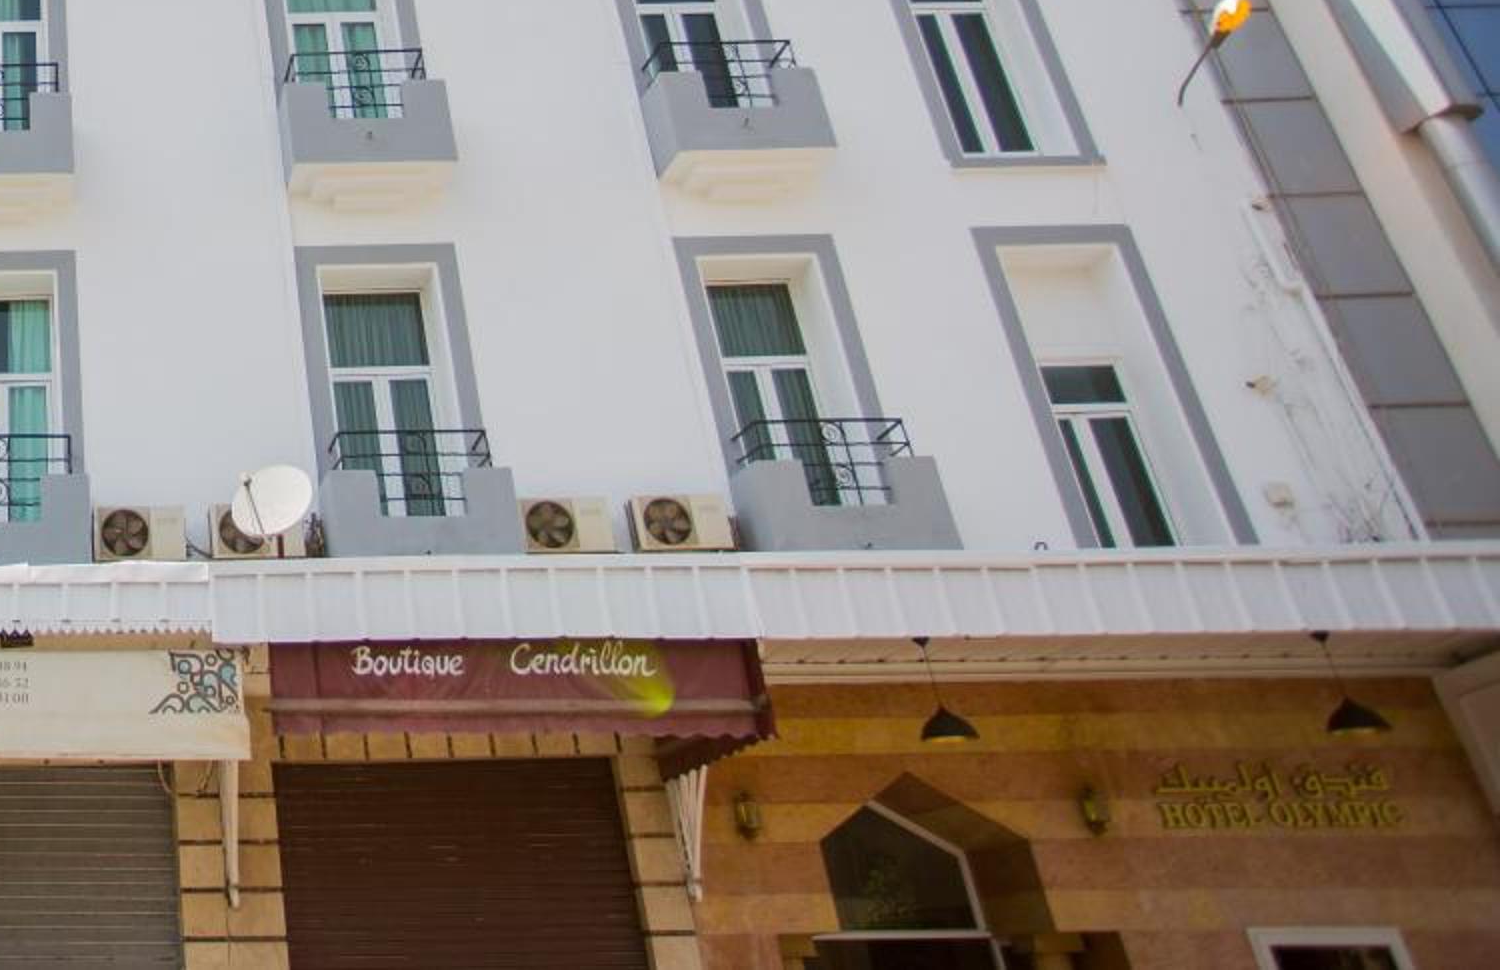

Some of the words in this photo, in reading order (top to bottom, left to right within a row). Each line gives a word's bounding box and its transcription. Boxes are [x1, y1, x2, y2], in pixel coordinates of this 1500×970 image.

[350, 645, 465, 677] Boutique
[509, 640, 656, 677] Cendrillon
[1159, 803, 1261, 828] HOTEL
[1269, 802, 1401, 828] OLYMPIC
